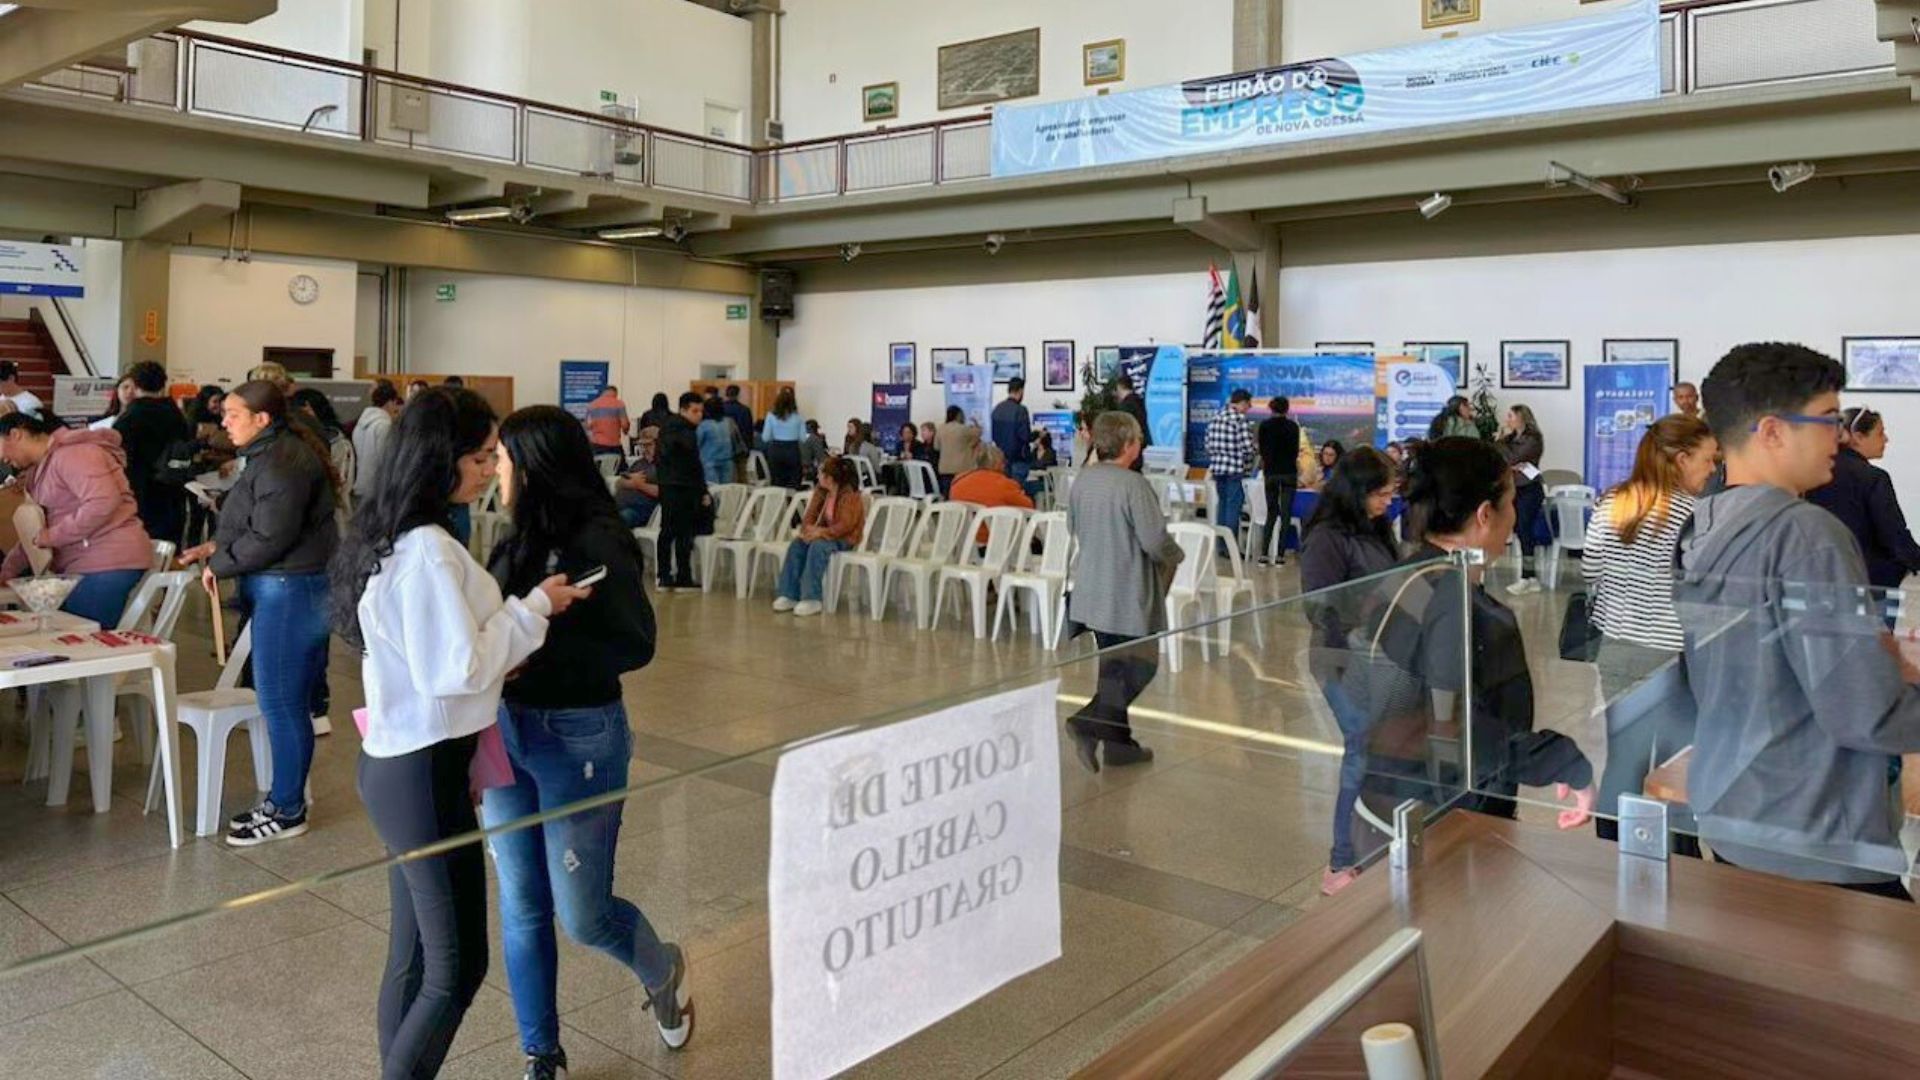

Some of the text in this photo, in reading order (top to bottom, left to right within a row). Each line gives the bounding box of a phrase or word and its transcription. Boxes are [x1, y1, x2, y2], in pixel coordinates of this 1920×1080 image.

[1205, 71, 1285, 102] FEIRÃO
[1181, 83, 1365, 136] EMPREGO
[1256, 114, 1365, 135] DE NOVA ODESSA
[1261, 364, 1314, 380] NOVA
